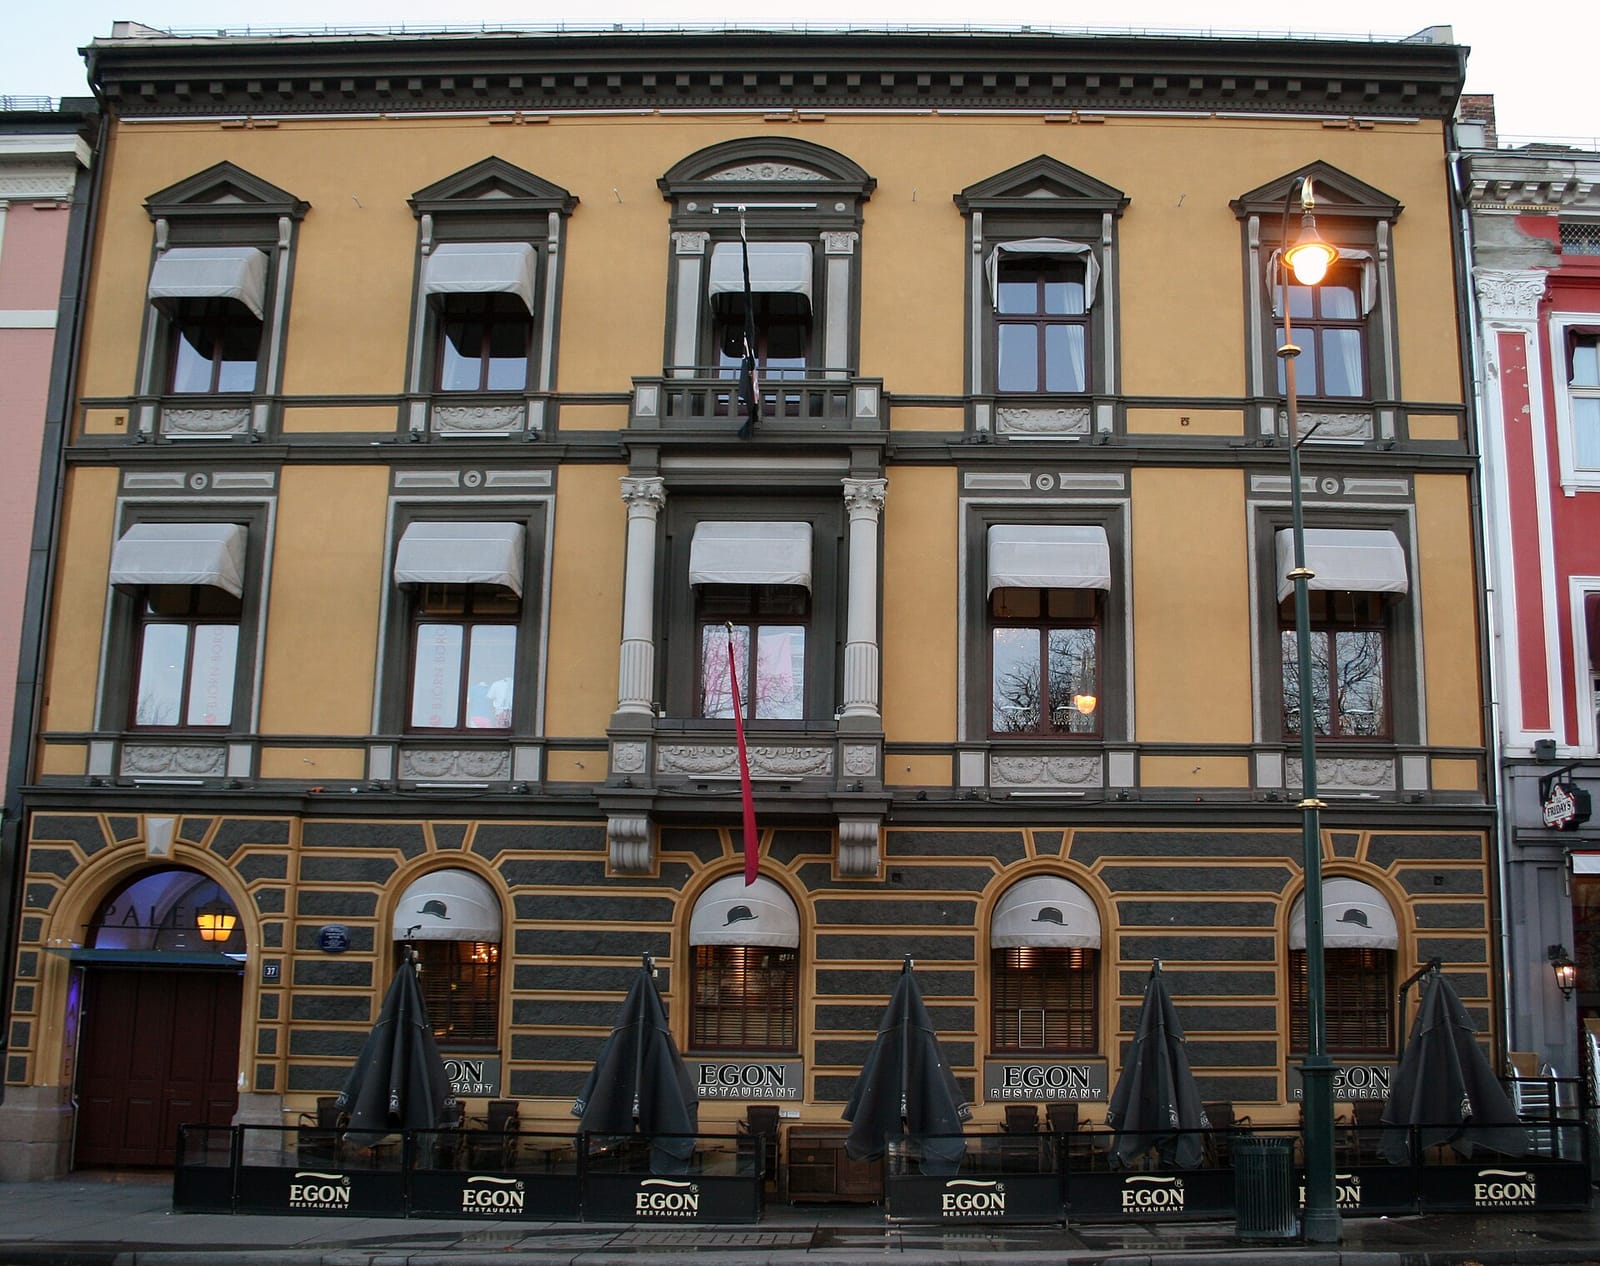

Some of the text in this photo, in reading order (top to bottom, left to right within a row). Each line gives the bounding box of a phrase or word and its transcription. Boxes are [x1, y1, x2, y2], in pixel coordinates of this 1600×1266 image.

[102, 905, 231, 928] PALEET
[443, 1060, 484, 1083] ON
[698, 1064, 785, 1087] EGON
[1002, 1066, 1091, 1088] EGON
[1332, 1066, 1391, 1088] ON
[697, 1087, 796, 1097] ESTAURANT
[991, 1088, 1101, 1099] RESTAURANT
[1294, 1088, 1391, 1099] RAURAN
[290, 1185, 351, 1202] EGON
[462, 1190, 525, 1207] EGON
[1121, 1189, 1185, 1206] EGON
[1474, 1183, 1536, 1200] EGON
[462, 1206, 523, 1214] RESTAURANT
[637, 1193, 701, 1210] EGON
[942, 1193, 1006, 1210] EGON
